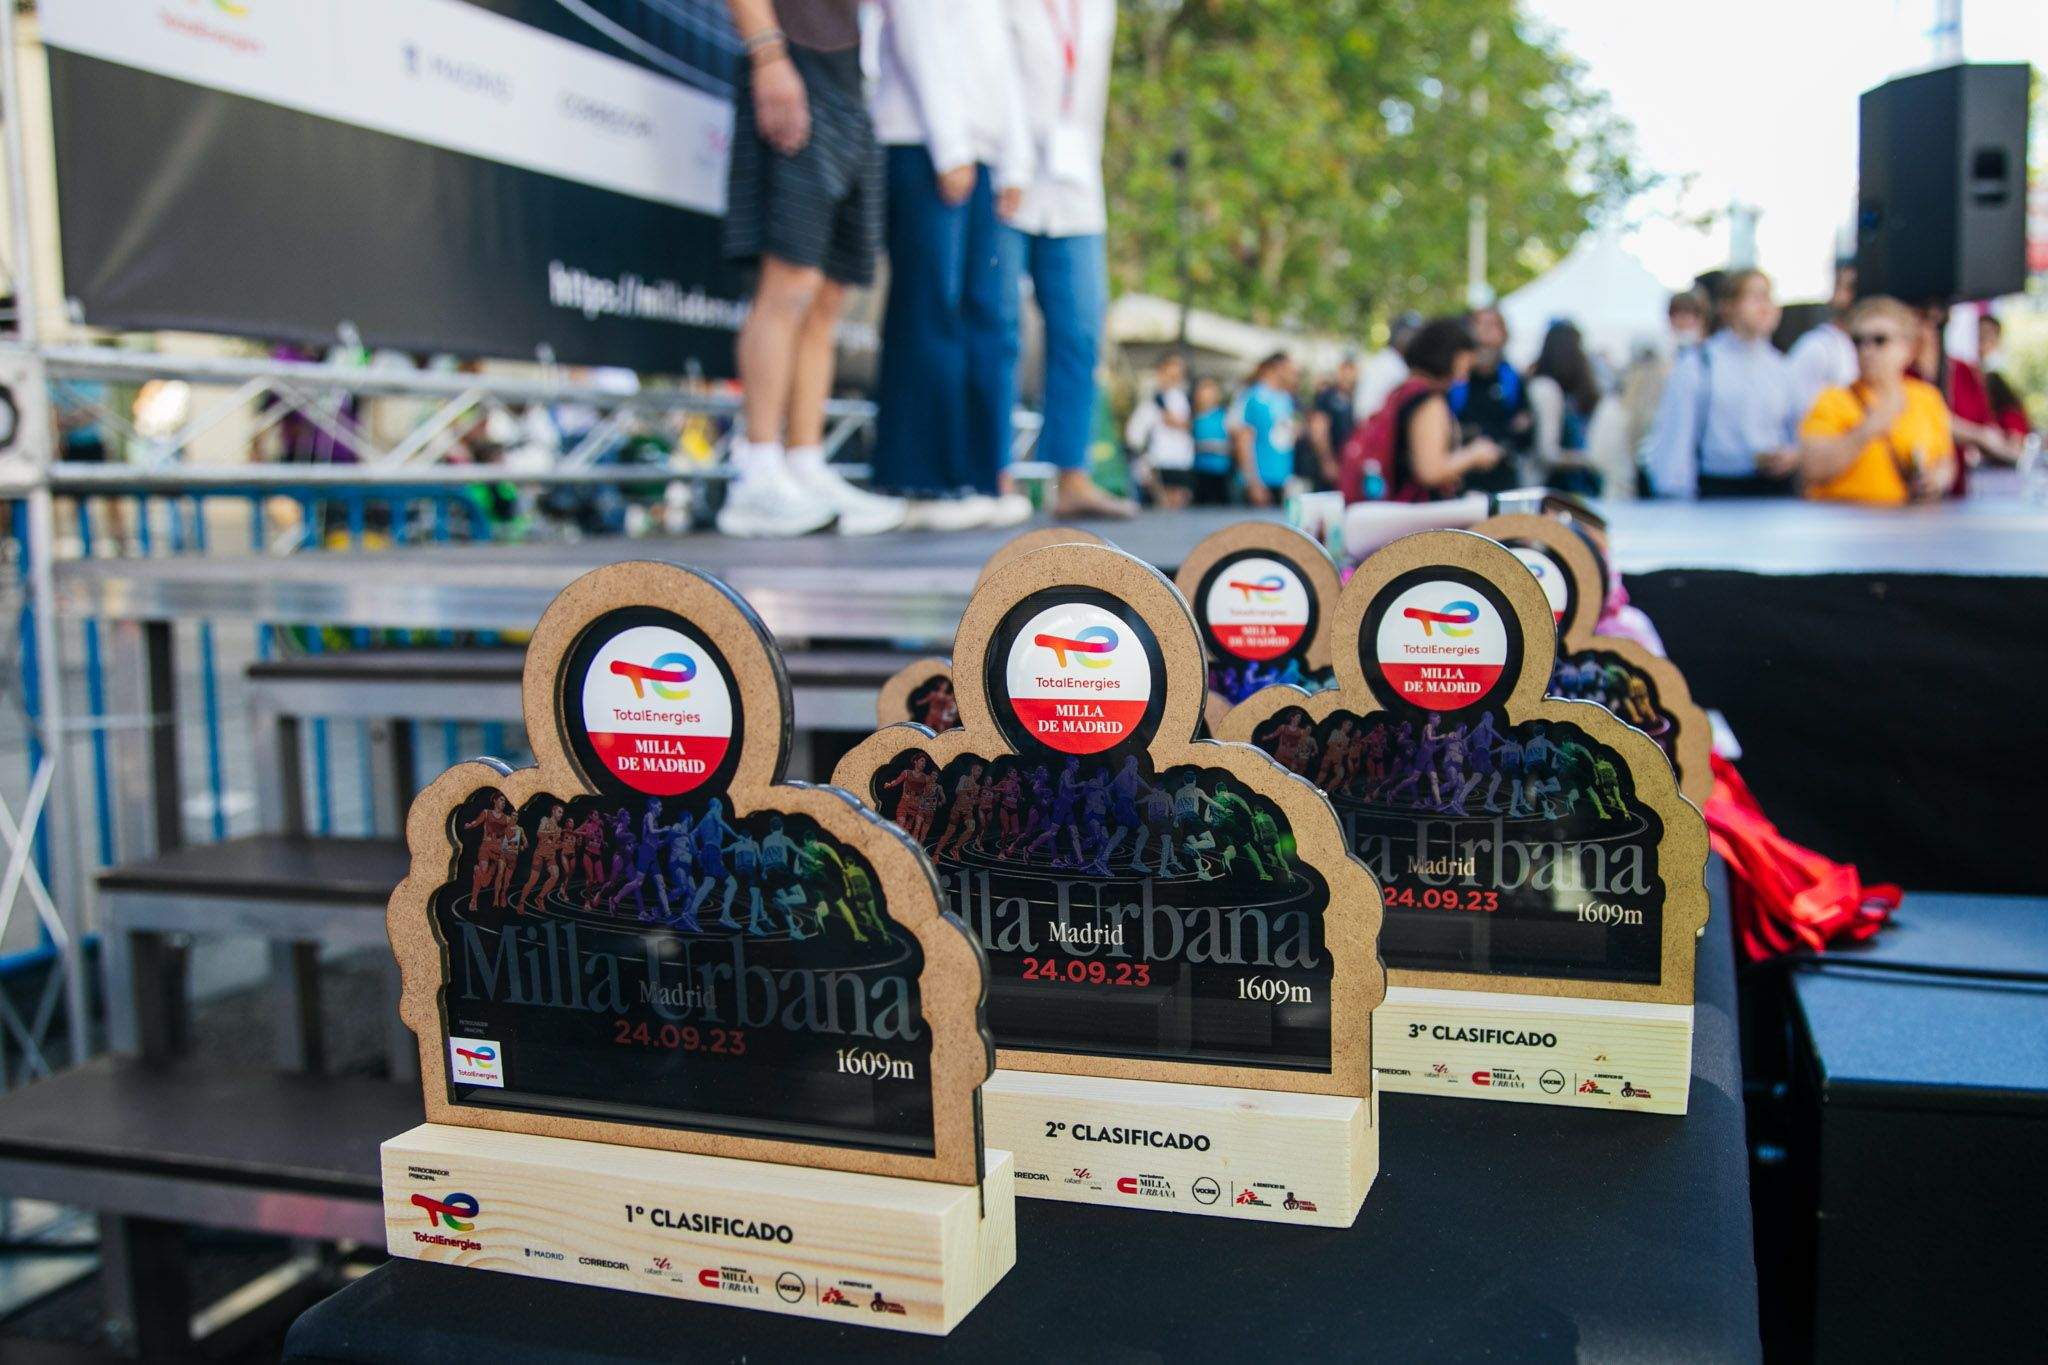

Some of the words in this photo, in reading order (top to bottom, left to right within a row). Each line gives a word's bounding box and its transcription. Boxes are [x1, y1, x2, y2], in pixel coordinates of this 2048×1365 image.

[1404, 644, 1480, 657] TotalEnergies
[1420, 668, 1464, 680] MILLA
[1035, 677, 1120, 691] TotalEnergies
[1404, 681, 1422, 693] DE
[1426, 682, 1481, 694] MADRID
[613, 709, 701, 726] TotalEnergies
[1055, 705, 1104, 718] MILLA
[1038, 720, 1059, 733] DE
[1062, 720, 1123, 734] MADRID
[635, 739, 686, 756] MILLA
[617, 757, 641, 771] DE
[643, 757, 706, 774] MADRID
[1411, 815, 1650, 897] Urbana
[1407, 855, 1476, 877] Madrid
[1384, 886, 1499, 912] 24.09.23
[1576, 902, 1644, 926] 1609m
[1052, 877, 1319, 969] Urbana
[1049, 921, 1125, 946] Madrid
[1022, 956, 1150, 987] 24.09.23
[456, 922, 630, 1015] Milla
[634, 932, 921, 1043] Urbana
[1237, 975, 1313, 1006] 1609m
[638, 979, 719, 1012] Madrid
[613, 1020, 748, 1056] 24.09.23
[1432, 1025, 1557, 1048] CLASIFICADO
[836, 1047, 915, 1081] 1609m
[458, 1069, 498, 1080] TotalEnergies
[1072, 1124, 1211, 1152] CLASIFICADO
[408, 1165, 449, 1177] PATROCINADOR
[408, 1173, 436, 1181] PRINCIPAL
[1140, 1178, 1171, 1189] MILLA
[1140, 1187, 1176, 1198] URBANA
[650, 1208, 794, 1244] CLASIFICADO
[413, 1231, 482, 1251] TotalEnergies
[533, 1250, 564, 1261] MADRID
[722, 1271, 754, 1284] MILLA
[721, 1281, 759, 1294] URBANA
